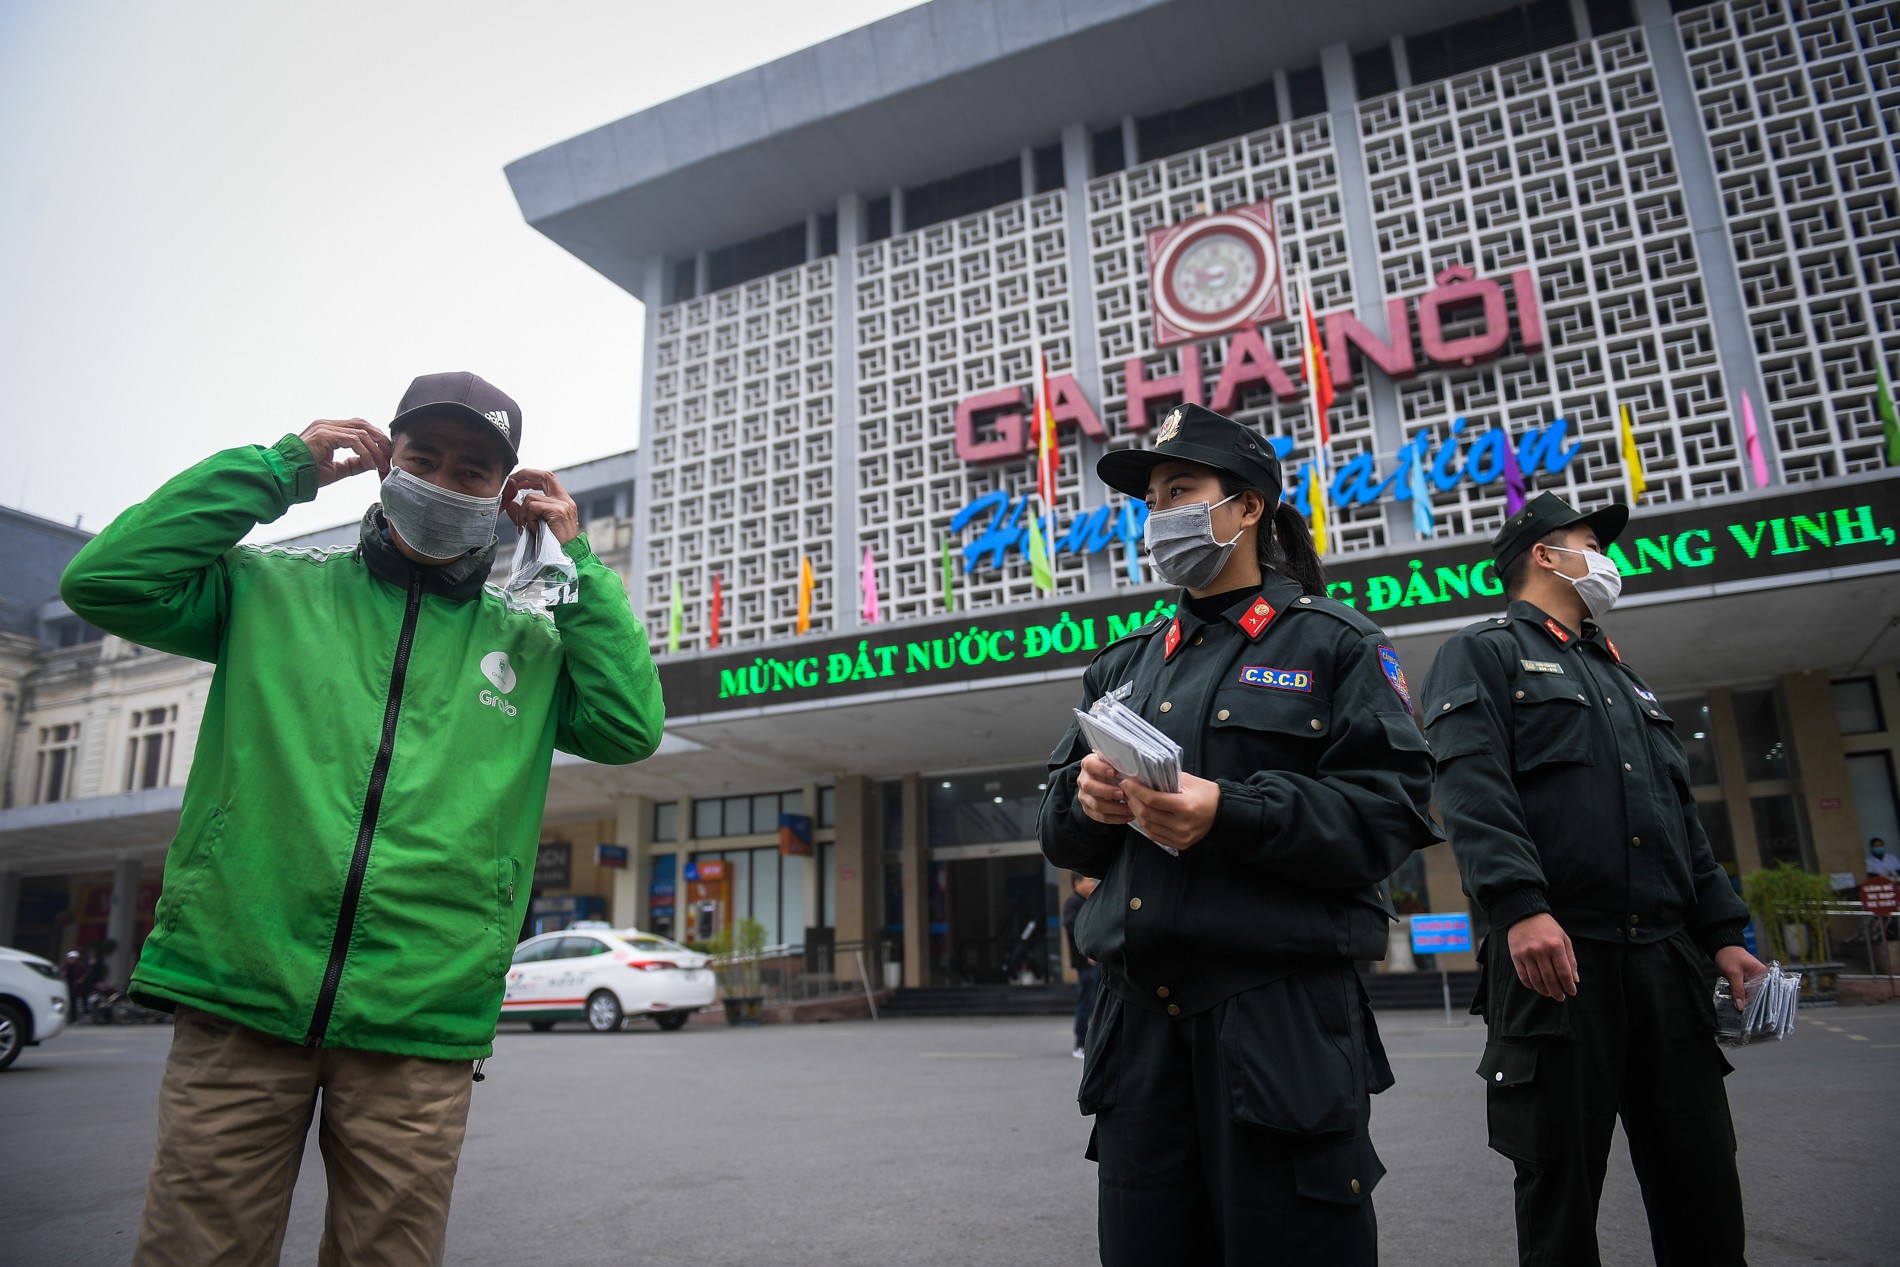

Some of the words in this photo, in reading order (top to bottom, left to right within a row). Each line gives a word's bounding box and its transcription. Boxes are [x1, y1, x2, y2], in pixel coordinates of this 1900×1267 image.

[956, 373, 1105, 463] GA
[1324, 264, 1545, 394] NỘI
[719, 657, 820, 699] MỪNG
[825, 639, 899, 684] ĐẤT
[905, 626, 1015, 674] NƯỚC
[1022, 611, 1099, 659] ĐỔI
[1365, 559, 1505, 612] ĐẢNG
[1727, 505, 1896, 559] VINH,
[479, 689, 517, 717] Grab
[1245, 668, 1308, 688] C.S.C.Đ
